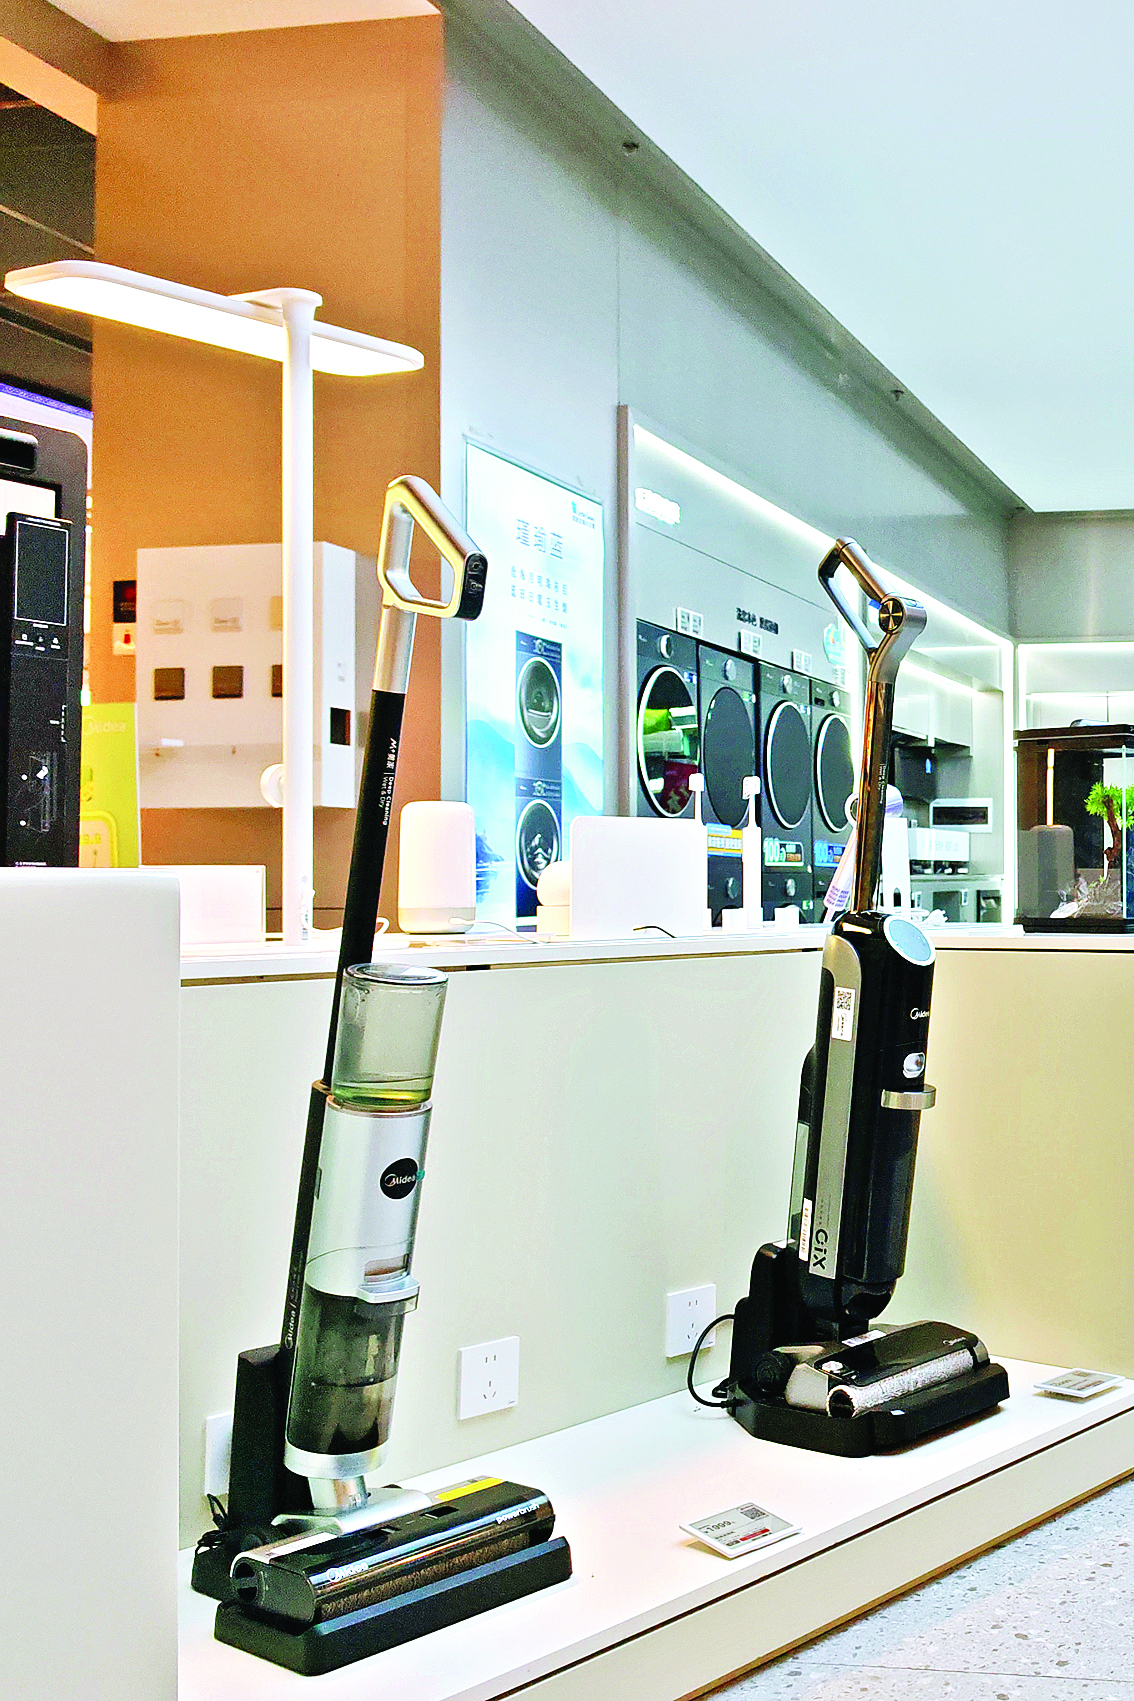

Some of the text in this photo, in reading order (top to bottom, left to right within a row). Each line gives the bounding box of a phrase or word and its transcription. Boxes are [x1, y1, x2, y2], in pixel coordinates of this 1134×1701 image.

[386, 776, 395, 795] Deep
[384, 1173, 416, 1188] Midea
[285, 1312, 297, 1349] Midea
[495, 1502, 540, 1524] powerbrush
[326, 1561, 369, 1583] Midea
